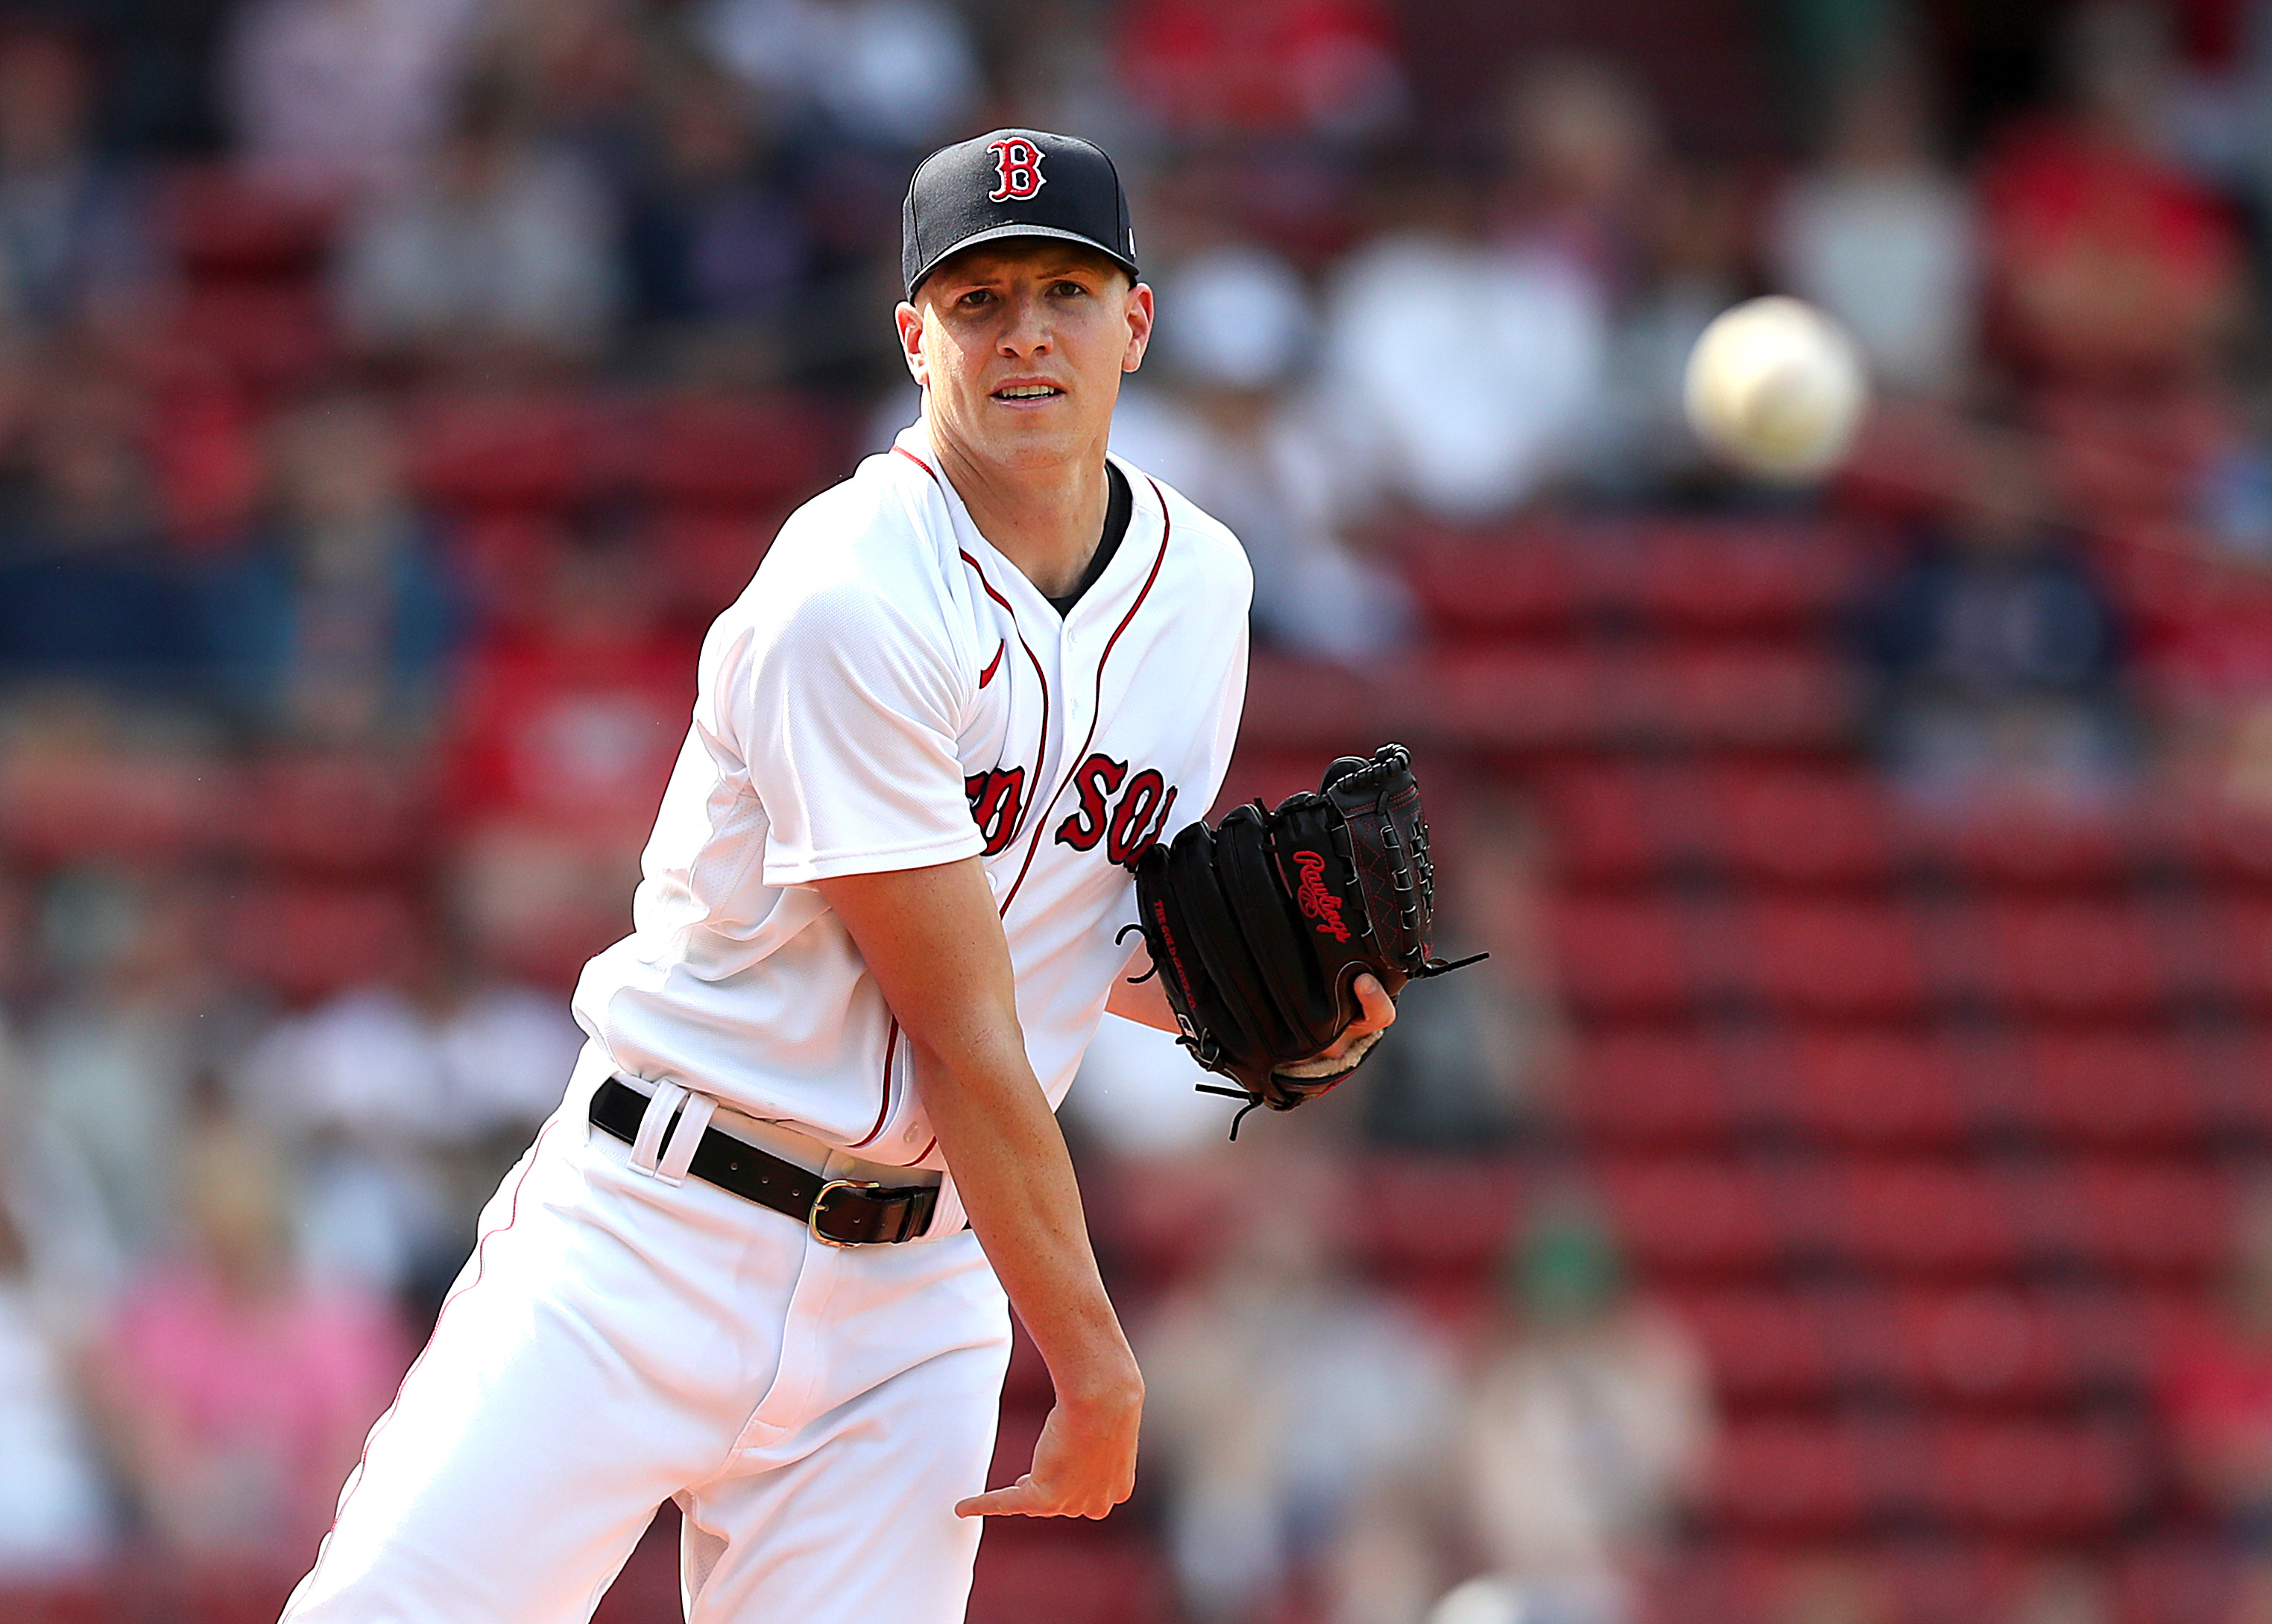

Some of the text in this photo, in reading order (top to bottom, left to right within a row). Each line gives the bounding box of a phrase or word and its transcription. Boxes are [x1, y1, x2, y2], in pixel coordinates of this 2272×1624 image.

[987, 137, 1047, 203] B
[1154, 899, 1167, 925] THE
[1161, 925, 1177, 956] GOLD
[1293, 850, 1351, 944] Rawlings
